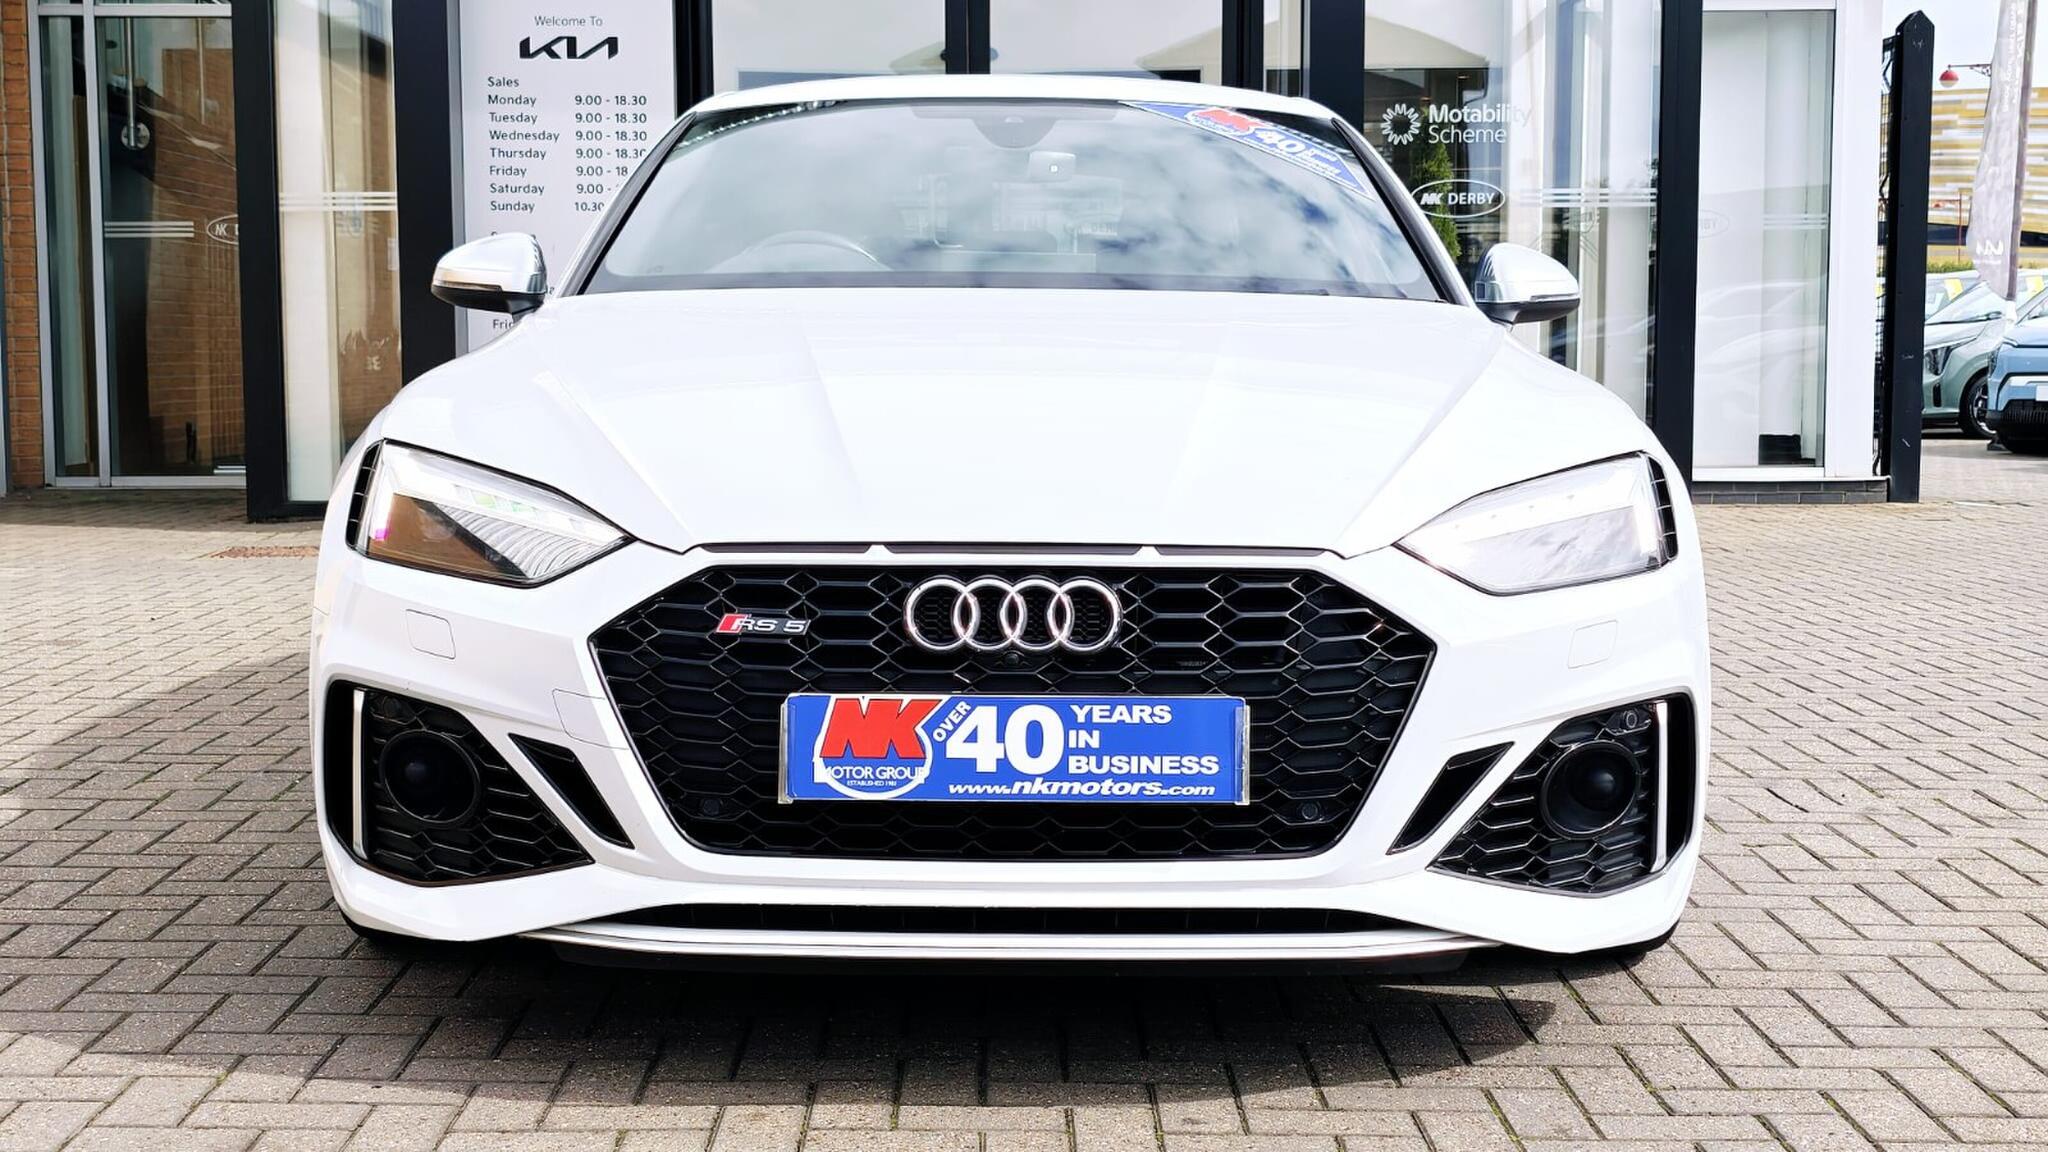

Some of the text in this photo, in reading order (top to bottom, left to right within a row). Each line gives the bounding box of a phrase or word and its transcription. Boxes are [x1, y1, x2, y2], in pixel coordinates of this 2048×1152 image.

[534, 15, 603, 27] Welcome To
[487, 76, 520, 88] Sales
[487, 94, 537, 108] Monday
[574, 95, 603, 106] 9.00
[615, 95, 647, 106] 18.30
[489, 111, 538, 125] Tuesday
[574, 113, 603, 123] 9.00
[615, 113, 647, 123] 18.30
[1428, 103, 1533, 128] Motability
[489, 129, 560, 143] Wednesday
[574, 130, 603, 141] 9.00
[615, 131, 648, 141] 18.30
[1428, 124, 1507, 144] Scheme
[490, 147, 547, 161] Thursday
[575, 148, 604, 159] 9.00
[489, 165, 528, 178] Friday
[575, 166, 604, 176] 9.00
[615, 166, 629, 176] 18
[490, 182, 545, 196] Saturday
[575, 184, 604, 194] 9.00
[1448, 192, 1495, 205] DERBY
[490, 200, 536, 214] Sunday
[730, 618, 807, 632] RS 5
[1069, 704, 1172, 724] YEARS
[819, 698, 943, 759] NK
[932, 700, 1065, 776] OVER 40
[1068, 729, 1100, 749] IN
[1068, 755, 1220, 775] BUSINESS
[948, 776, 1216, 797] www.nkmotors.com
